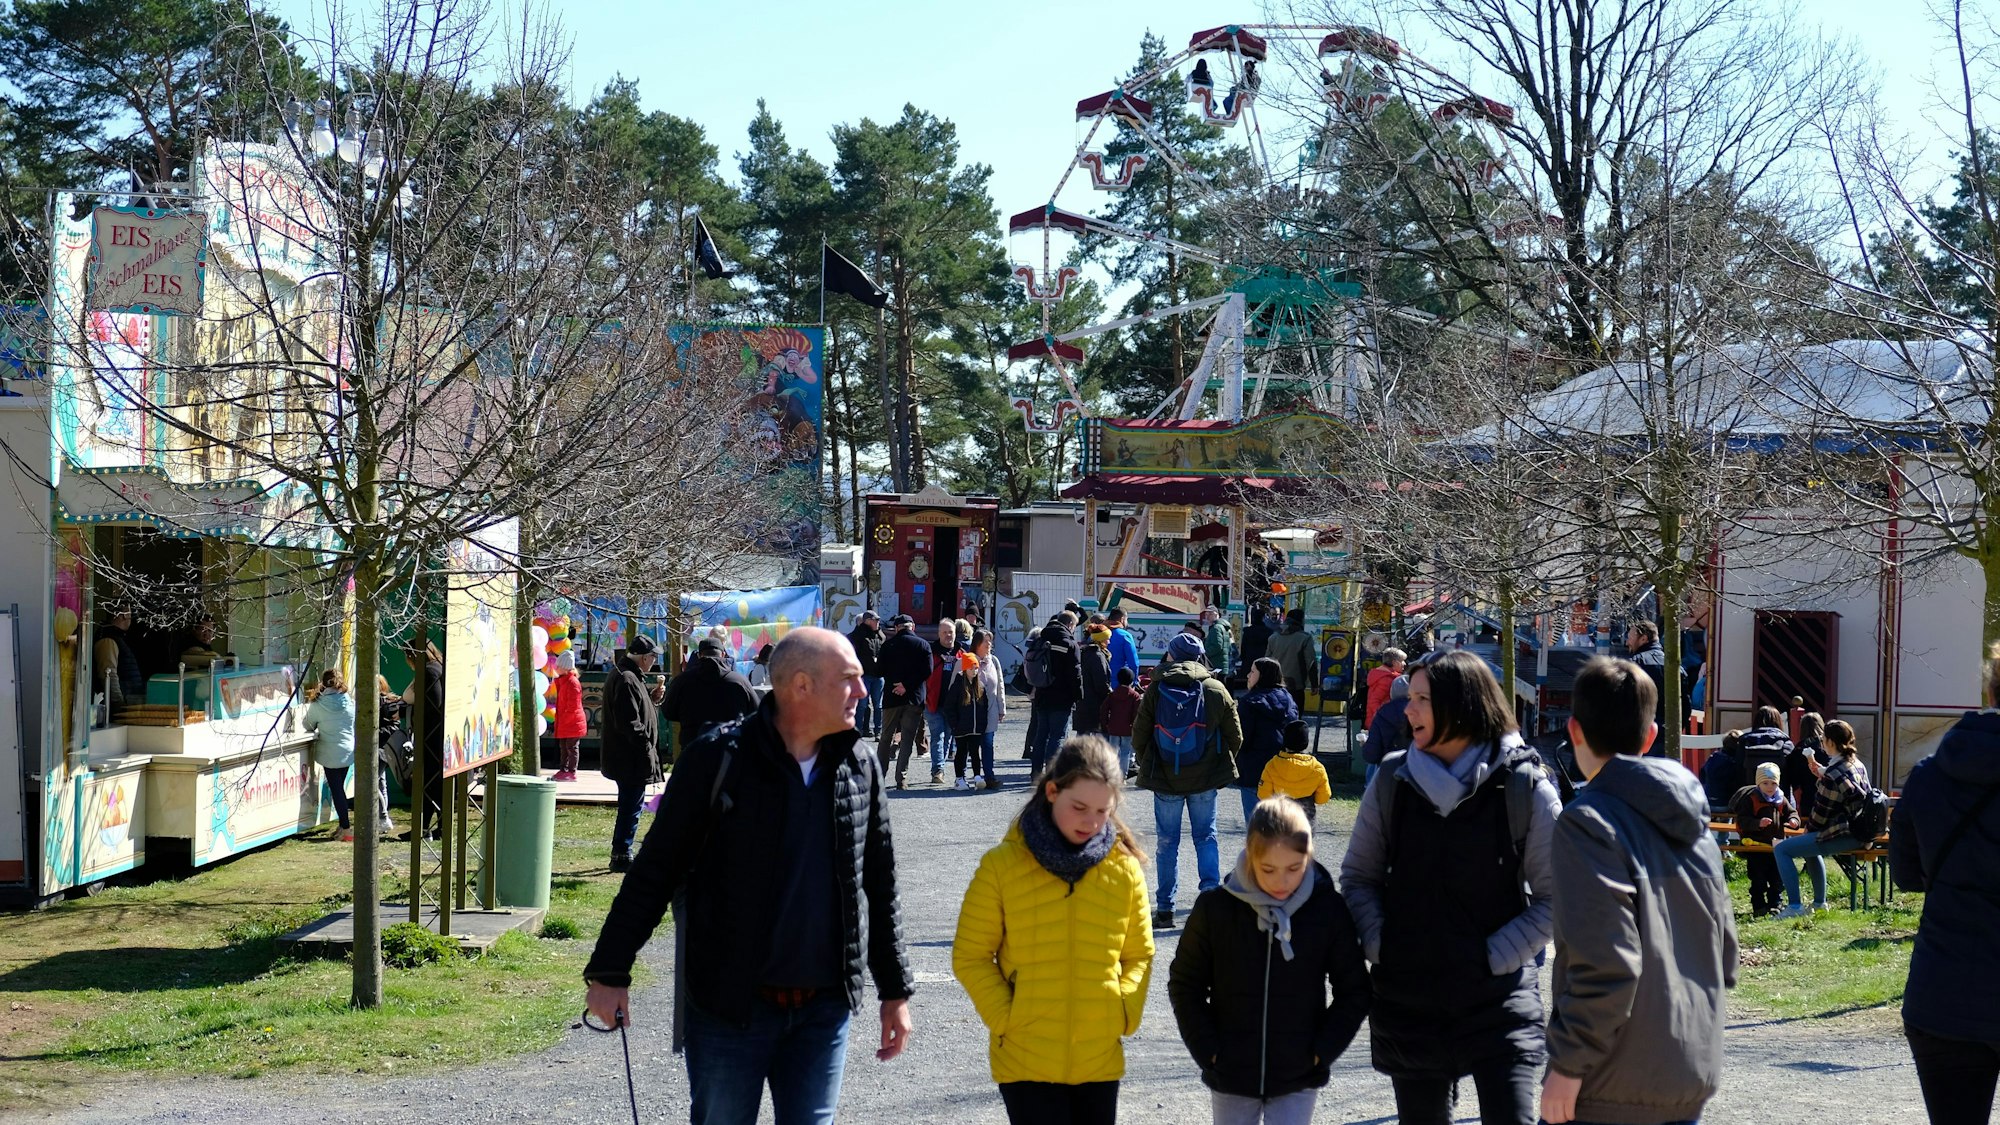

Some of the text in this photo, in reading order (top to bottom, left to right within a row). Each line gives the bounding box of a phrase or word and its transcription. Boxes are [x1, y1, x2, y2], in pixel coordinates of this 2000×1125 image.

[111, 225, 150, 248] EIS
[142, 273, 182, 296] EIS
[908, 497, 958, 506] CHARLATAN
[915, 515, 951, 524] GILBERT
